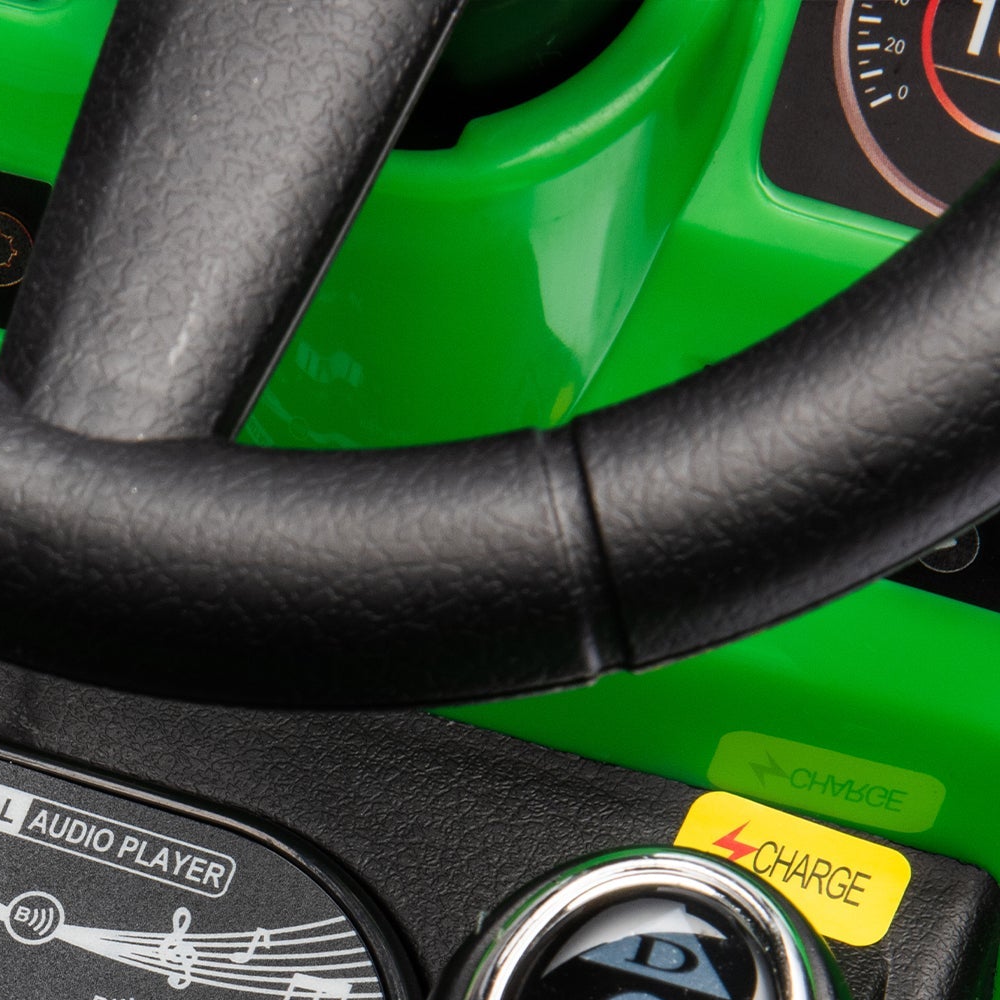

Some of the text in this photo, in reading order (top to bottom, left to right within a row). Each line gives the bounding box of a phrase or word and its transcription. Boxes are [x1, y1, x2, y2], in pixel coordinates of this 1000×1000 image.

[884, 36, 906, 55] 20
[967, 0, 1000, 57] 1
[897, 84, 909, 100] 0
[27, 809, 115, 853] AUDIO
[117, 836, 226, 889] PLAYER
[752, 840, 873, 907] CHARGE
[624, 934, 699, 973] D
